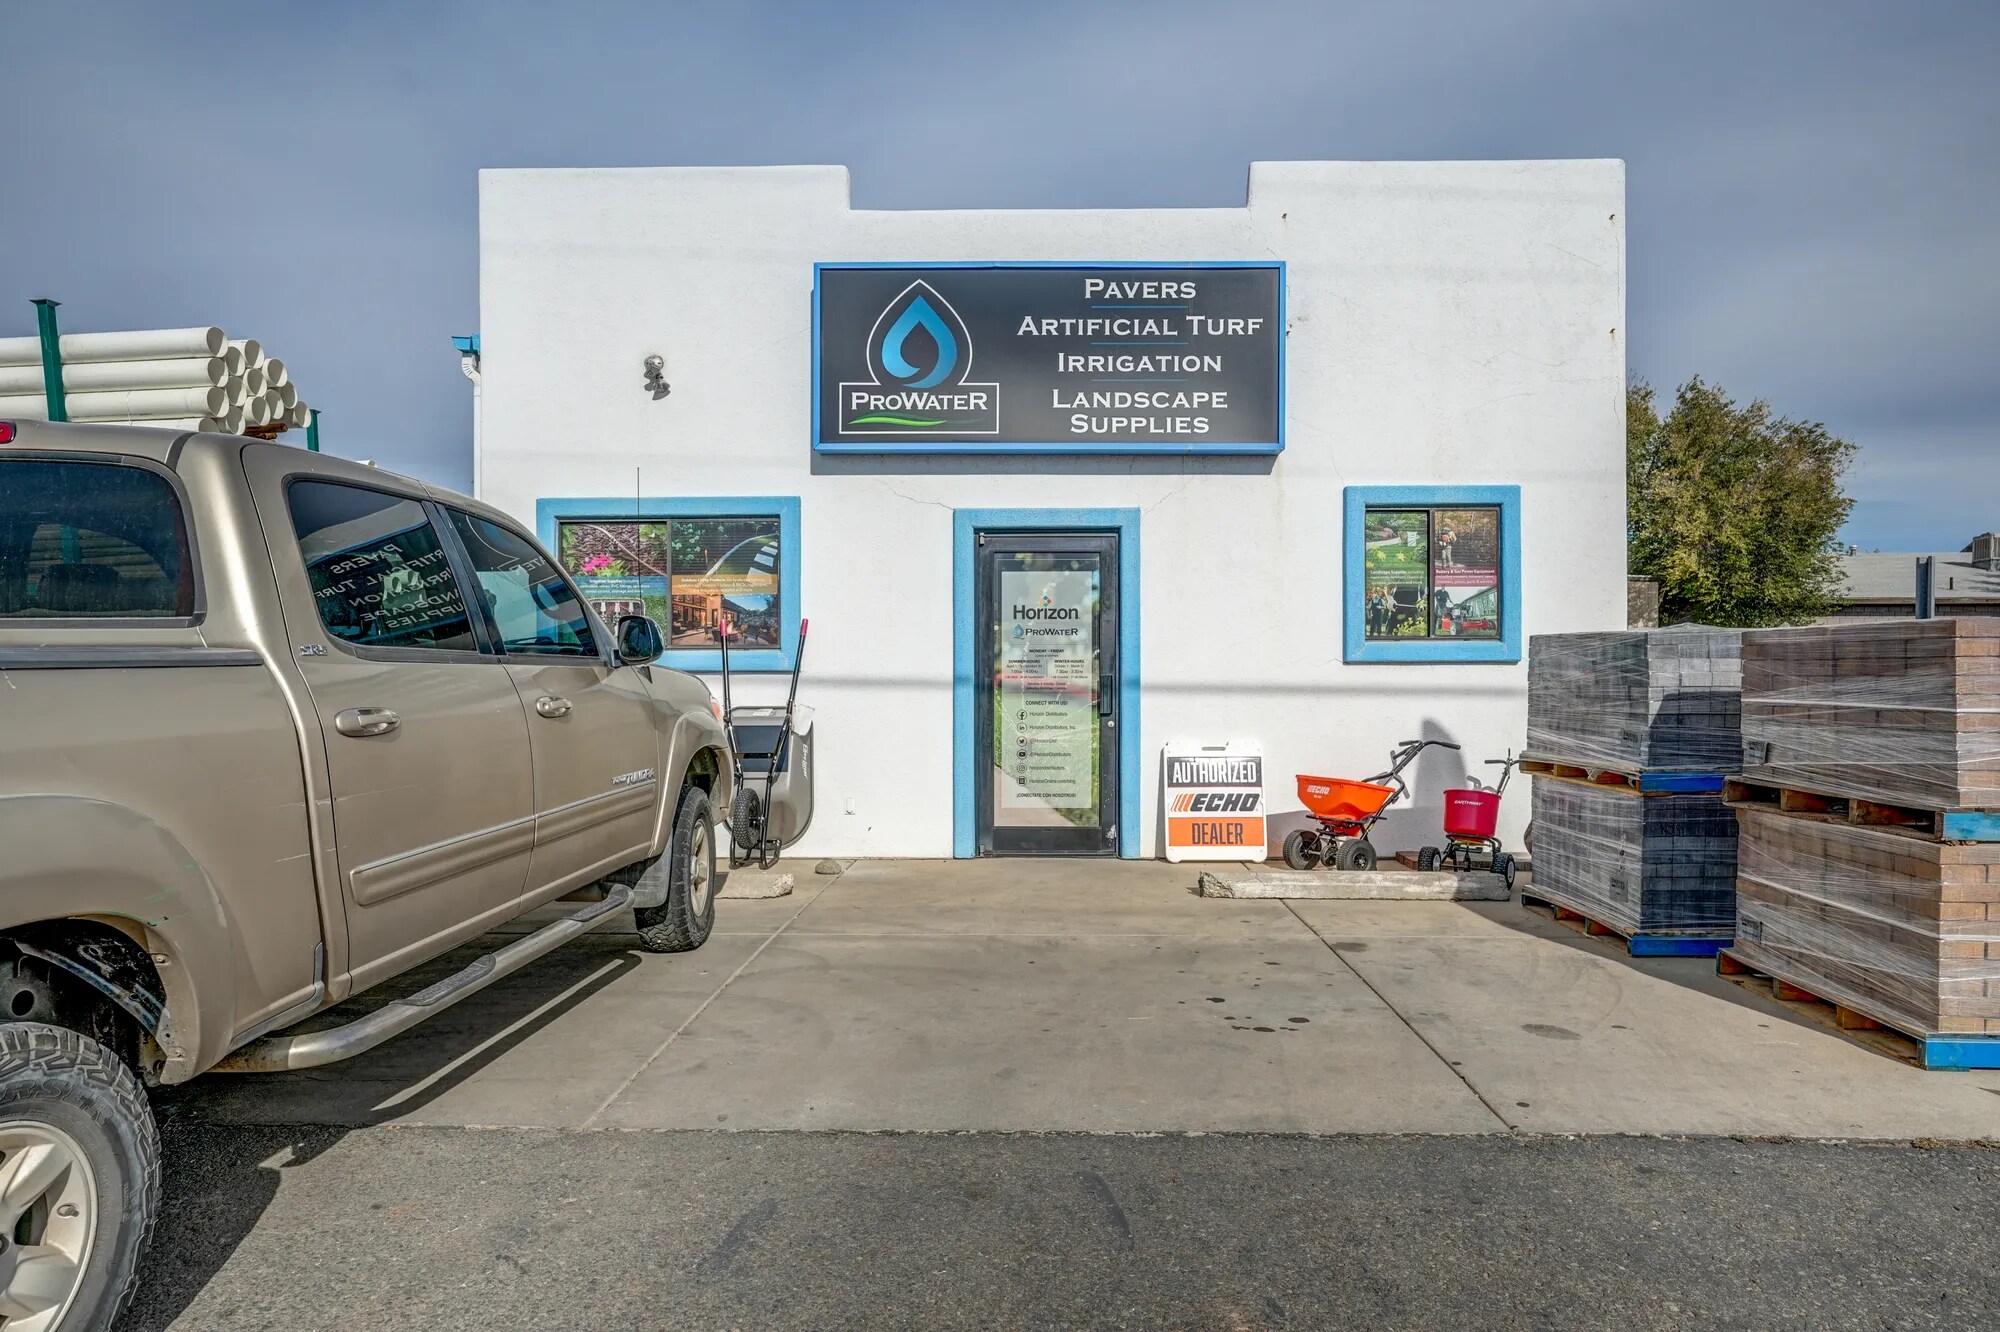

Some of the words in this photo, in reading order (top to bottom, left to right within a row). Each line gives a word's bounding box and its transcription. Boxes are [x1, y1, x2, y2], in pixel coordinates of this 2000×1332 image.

[1084, 278, 1197, 299] PAVERS
[1016, 315, 1178, 336] ARTIFICIAL
[1185, 314, 1264, 335] TURF
[1057, 352, 1222, 372] IRRIGATION
[1052, 388, 1228, 409] LANDSCAPE
[1070, 413, 1210, 434] SUPPLIES
[1013, 604, 1079, 620] Horizon
[1172, 760, 1257, 783] AUTHORIZED
[1311, 785, 1331, 795] ECHO
[1189, 793, 1260, 812] ECHO
[1191, 822, 1244, 845] DEALER
